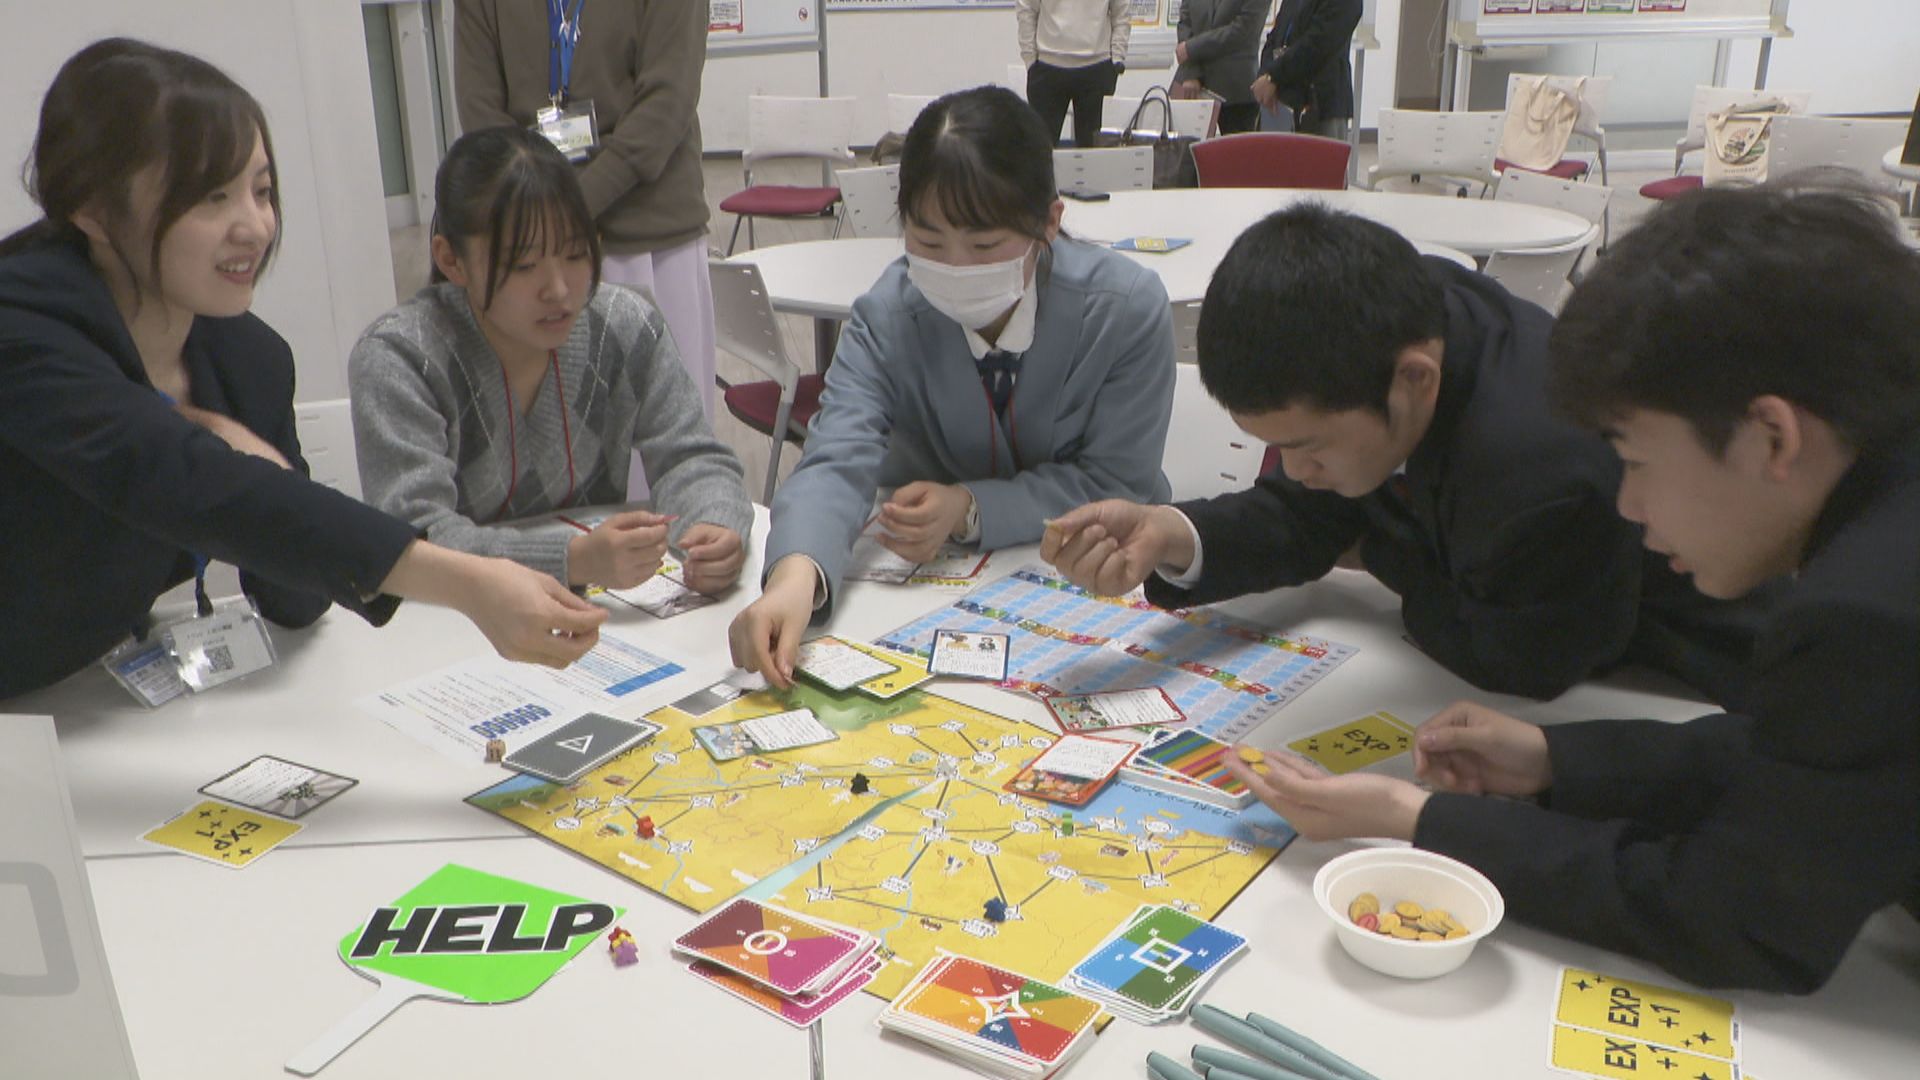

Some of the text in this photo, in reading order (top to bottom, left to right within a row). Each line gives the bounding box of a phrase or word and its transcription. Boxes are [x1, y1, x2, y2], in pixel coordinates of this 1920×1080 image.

[1344, 729, 1390, 751] EXP
[213, 821, 263, 851] EXP
[350, 903, 615, 958] HELP
[1608, 987, 1641, 1028] EXP
[1650, 1003, 1681, 1029] +1
[1605, 1038, 1637, 1070] EX
